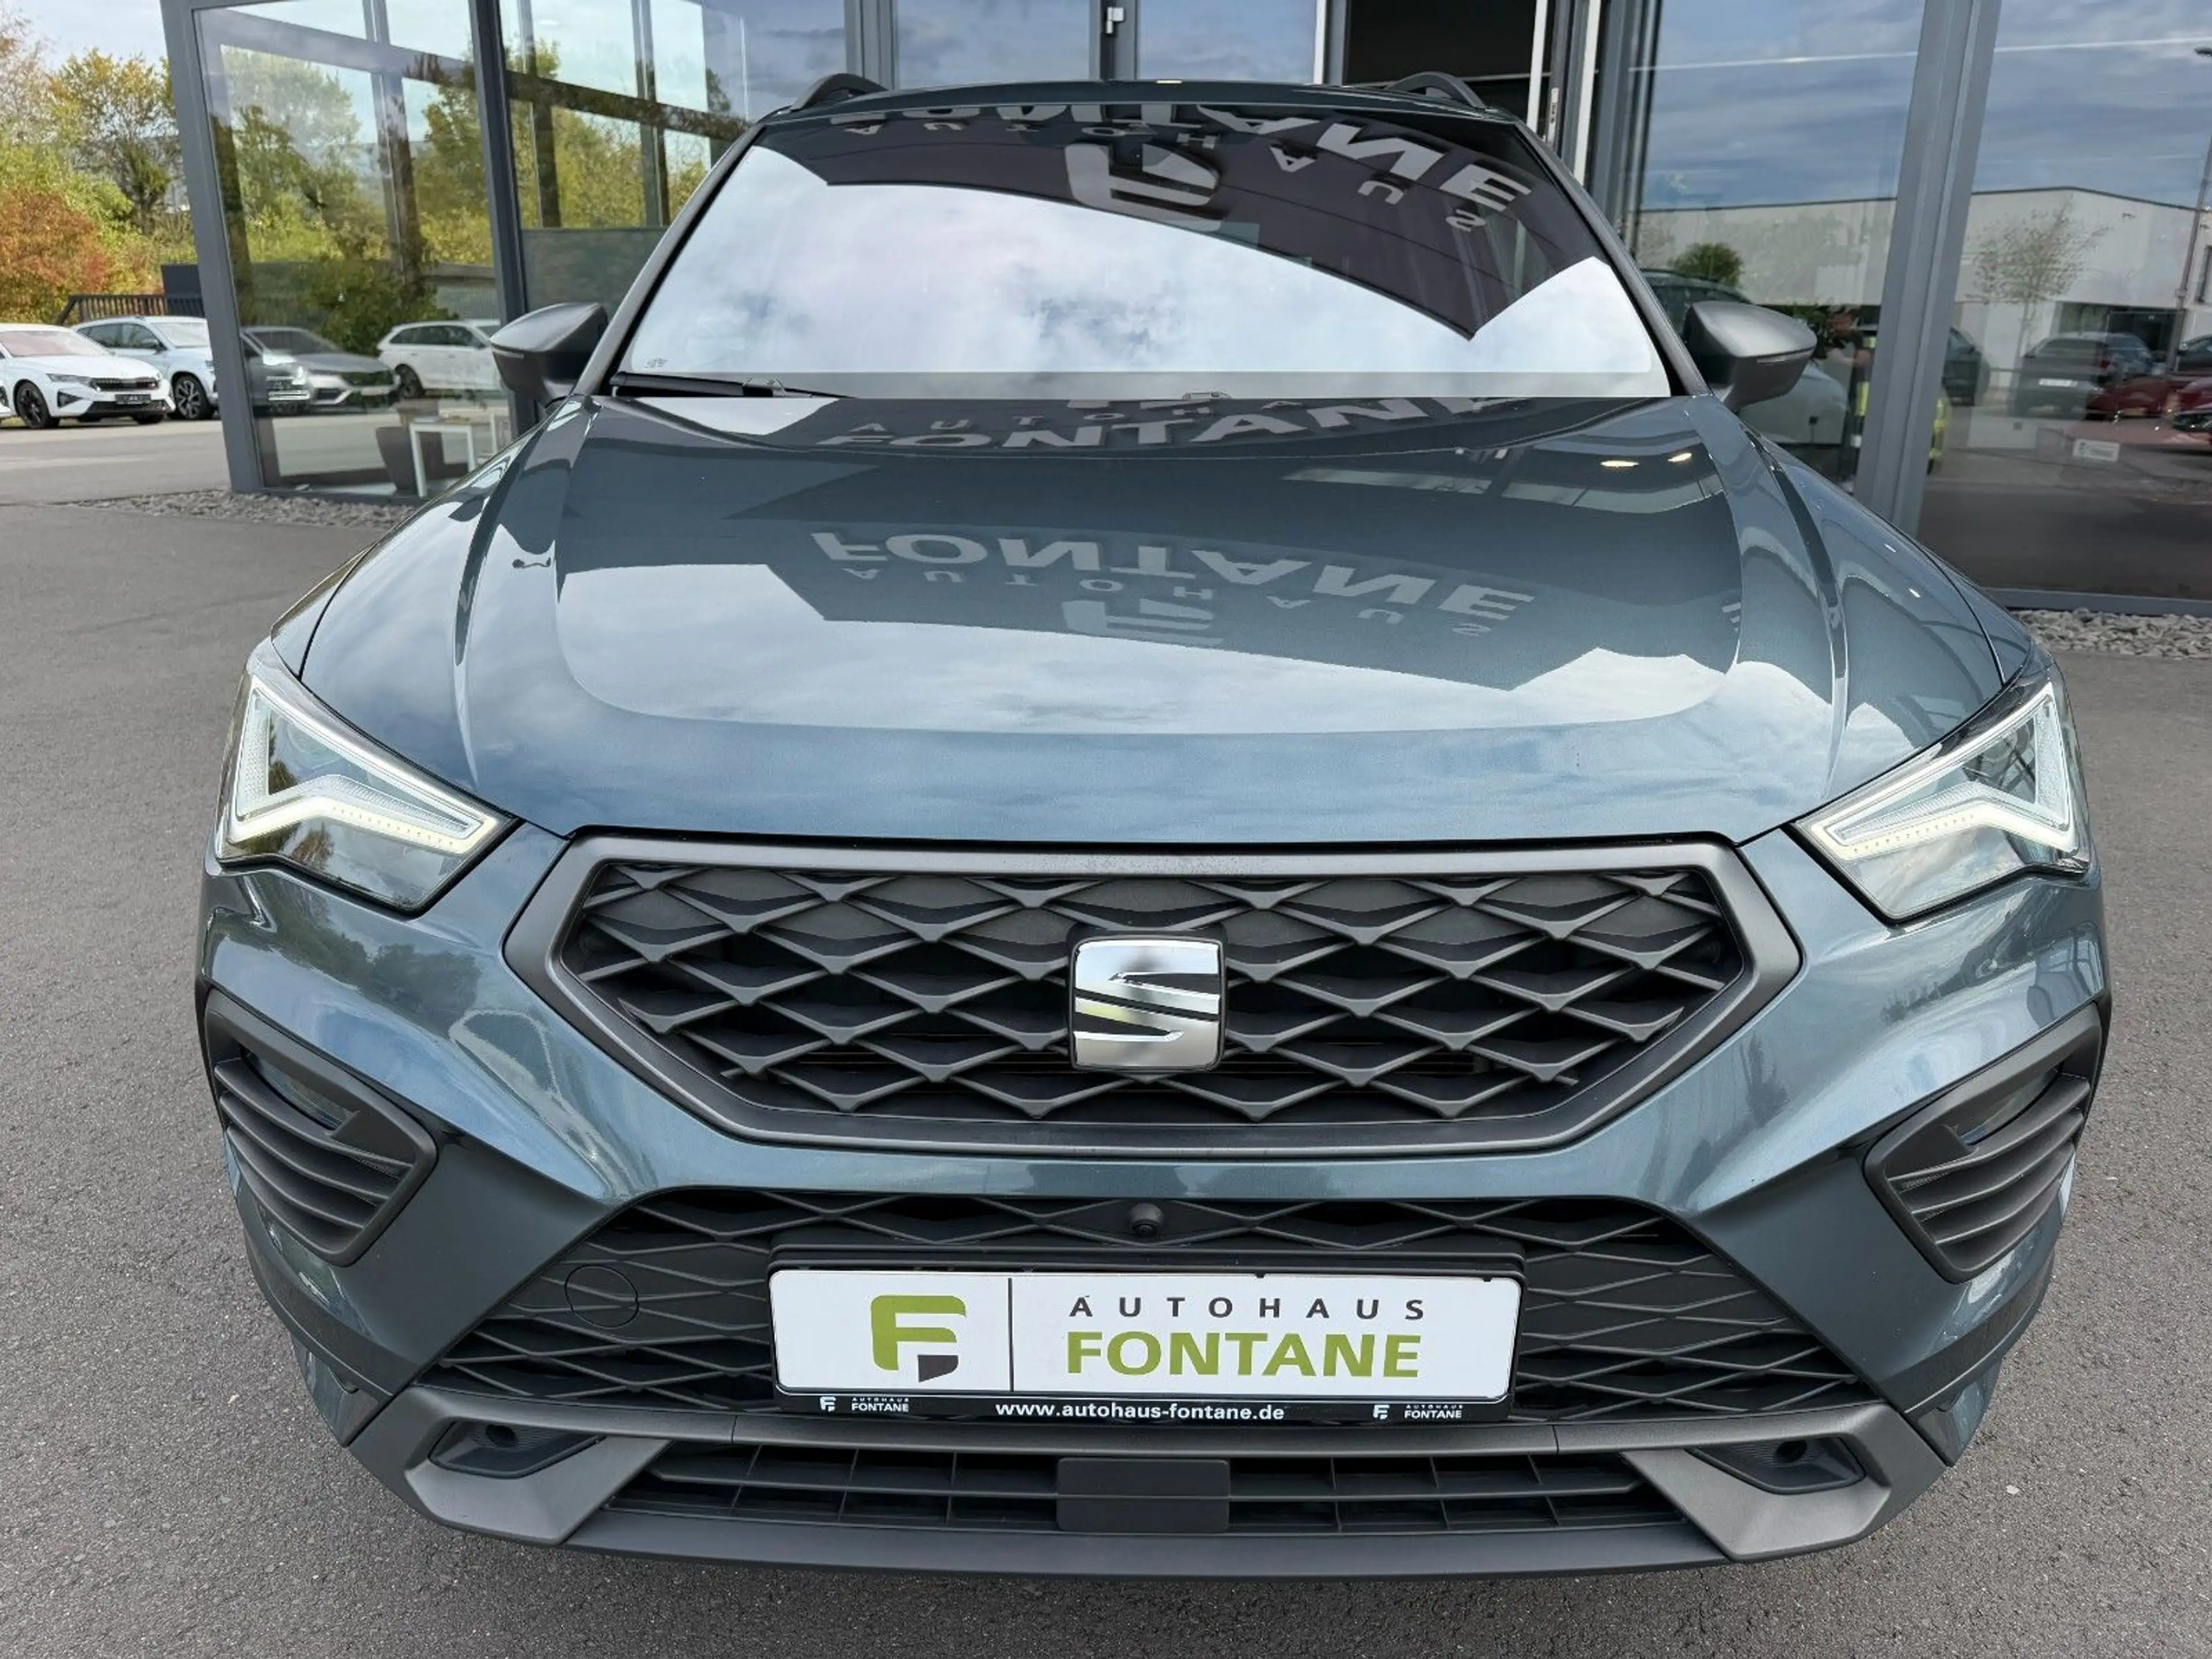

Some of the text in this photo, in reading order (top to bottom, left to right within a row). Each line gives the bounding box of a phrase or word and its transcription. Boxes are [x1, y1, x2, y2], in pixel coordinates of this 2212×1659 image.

[1069, 1294, 1425, 1321] AUTOHAUS
[1067, 1331, 1422, 1377] FONTANE
[851, 1403, 910, 1412] FONTANE
[995, 1402, 1285, 1421] www.autohaus-fontane.de
[1404, 1410, 1463, 1419] FONTANE
